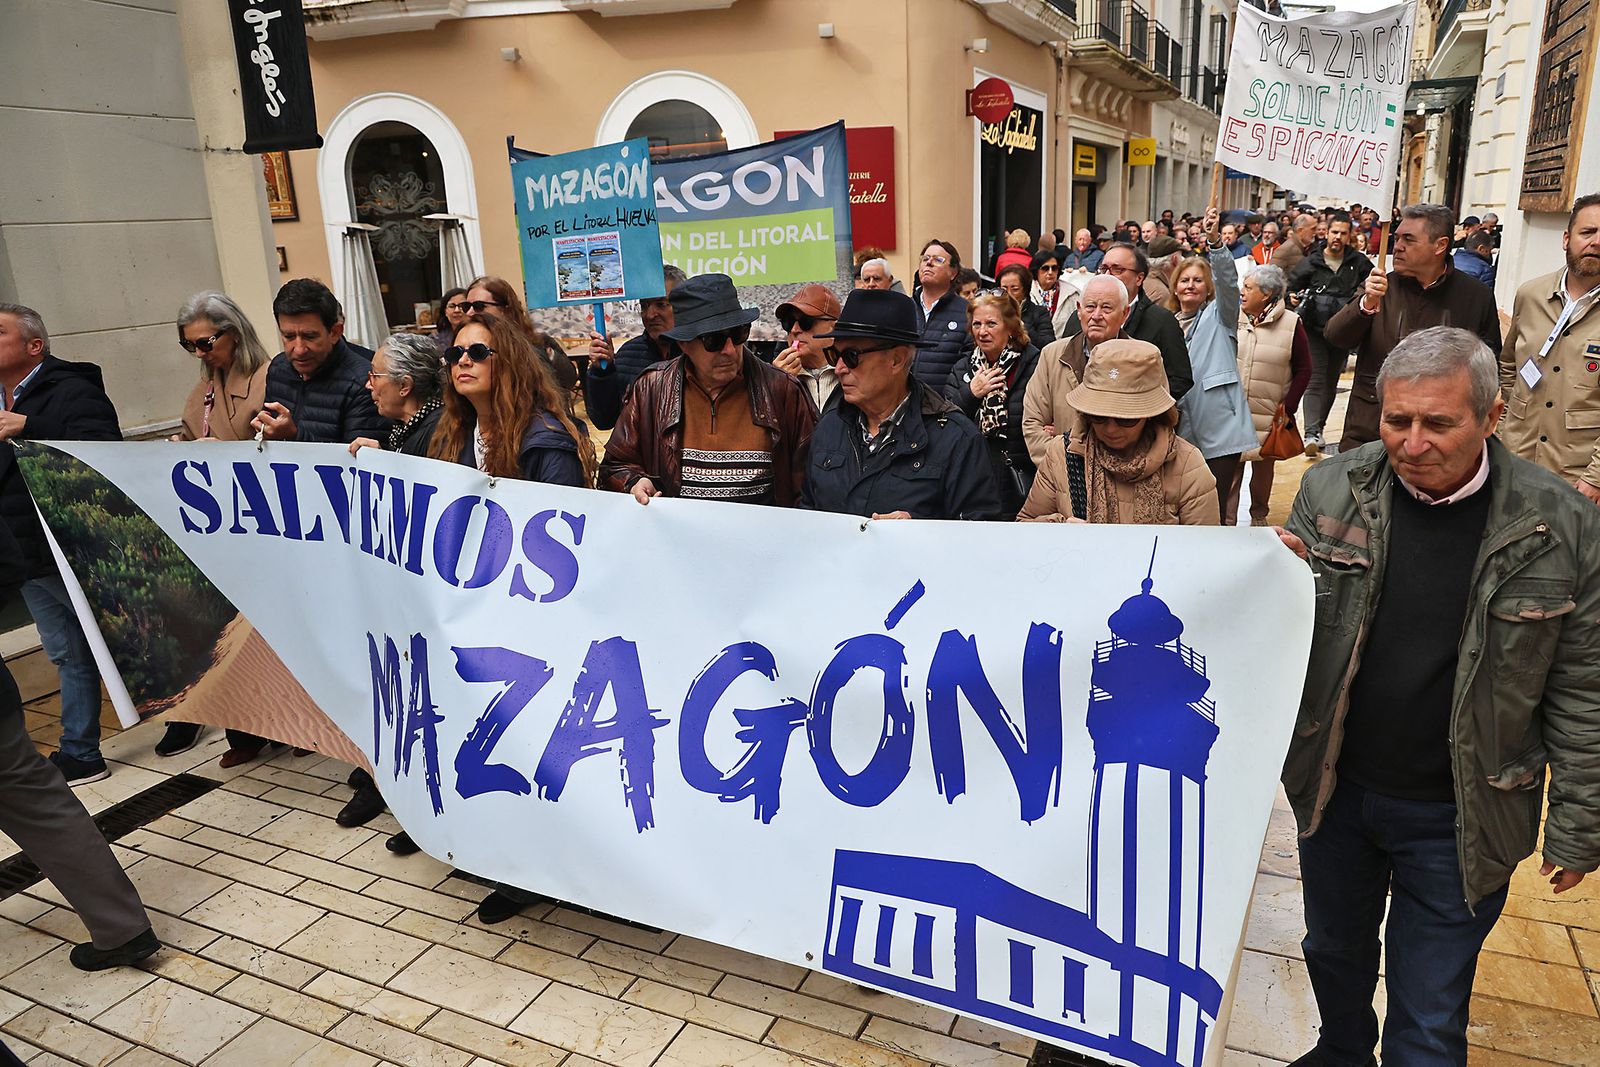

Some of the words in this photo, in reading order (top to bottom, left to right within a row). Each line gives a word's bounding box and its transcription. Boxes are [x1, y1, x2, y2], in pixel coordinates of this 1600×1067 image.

[525, 146, 649, 210] MAZAGÓN
[653, 146, 826, 213] AGON
[848, 172, 871, 180] ZZERIE
[527, 227, 551, 240] POR
[554, 220, 569, 235] EL
[616, 207, 657, 230] HUELVA
[689, 230, 733, 251] DEL
[738, 222, 829, 248] LITORAL
[663, 251, 767, 277] UCIÓN
[171, 460, 587, 603] SALVEMOS
[366, 579, 1063, 834] MAZAGÓN
